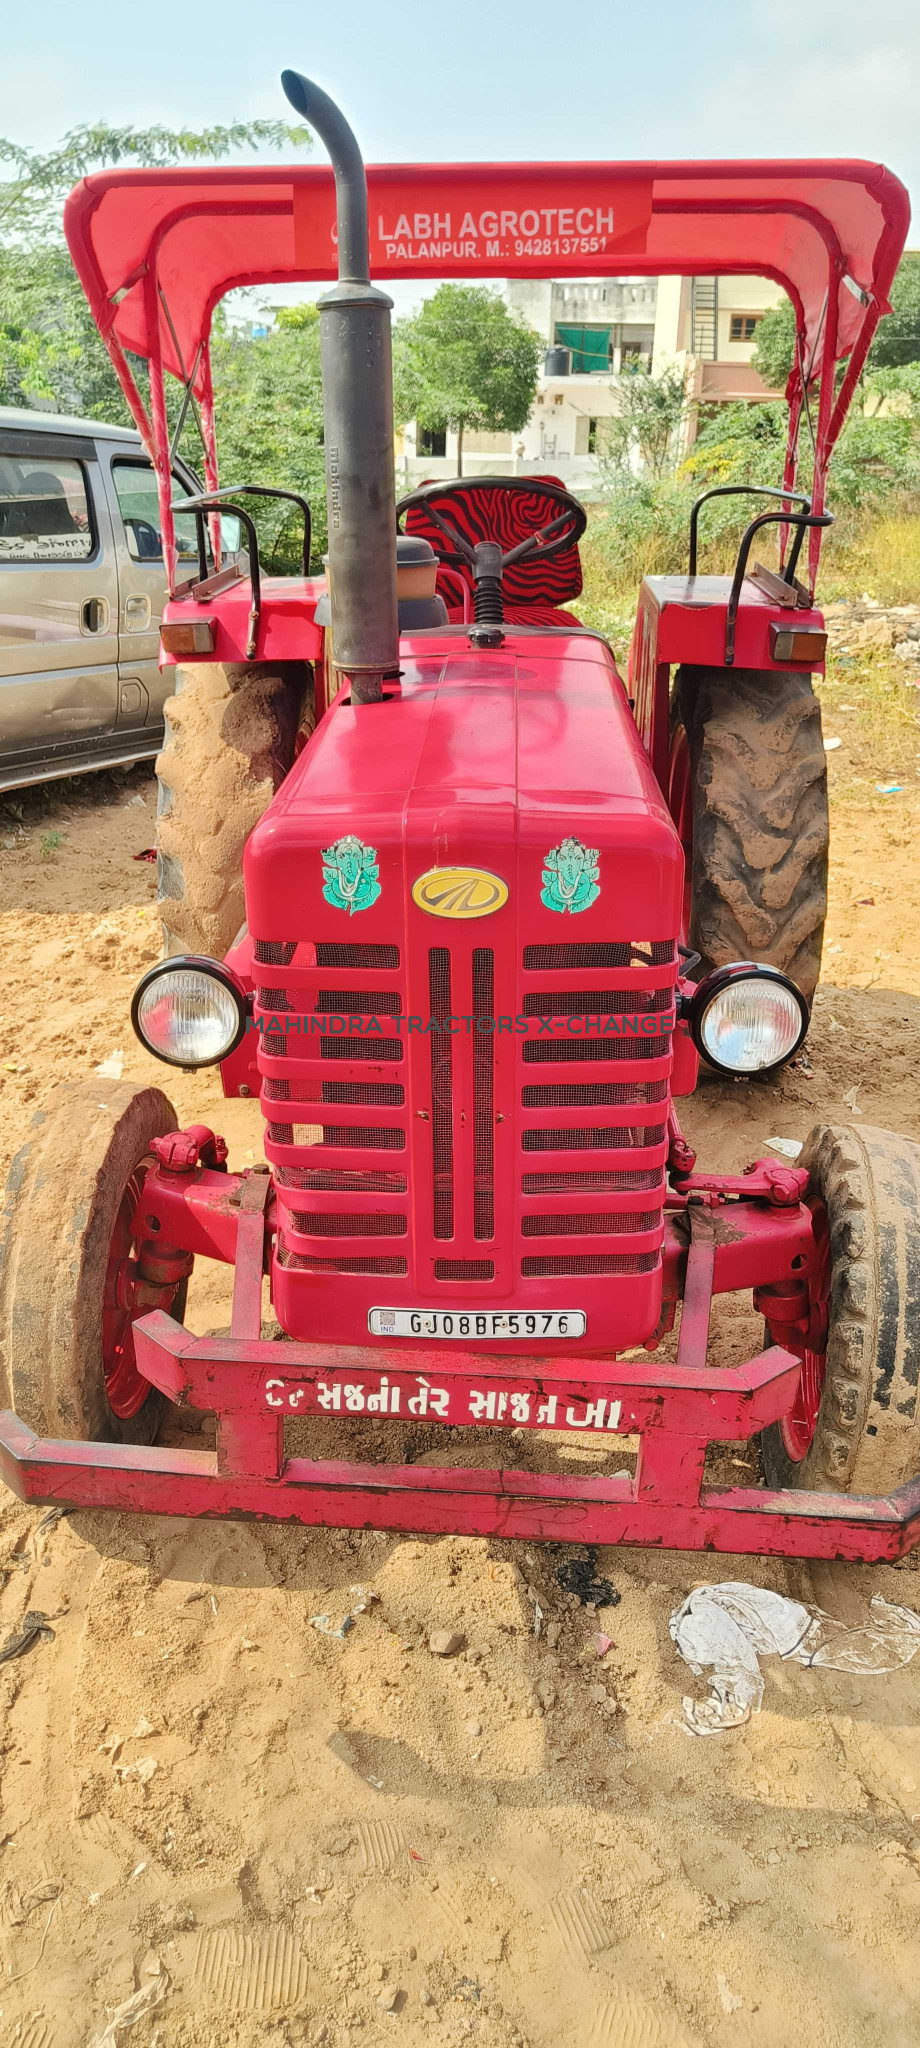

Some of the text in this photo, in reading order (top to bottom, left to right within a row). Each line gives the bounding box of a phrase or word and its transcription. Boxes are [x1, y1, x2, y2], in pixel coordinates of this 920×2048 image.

[378, 207, 614, 241] LABH AGROTECH
[386, 241, 481, 260] PALANPUR.
[514, 236, 607, 257] 9428137551
[330, 446, 341, 529] mahindra
[410, 1313, 569, 1336] GJ08BF5976
